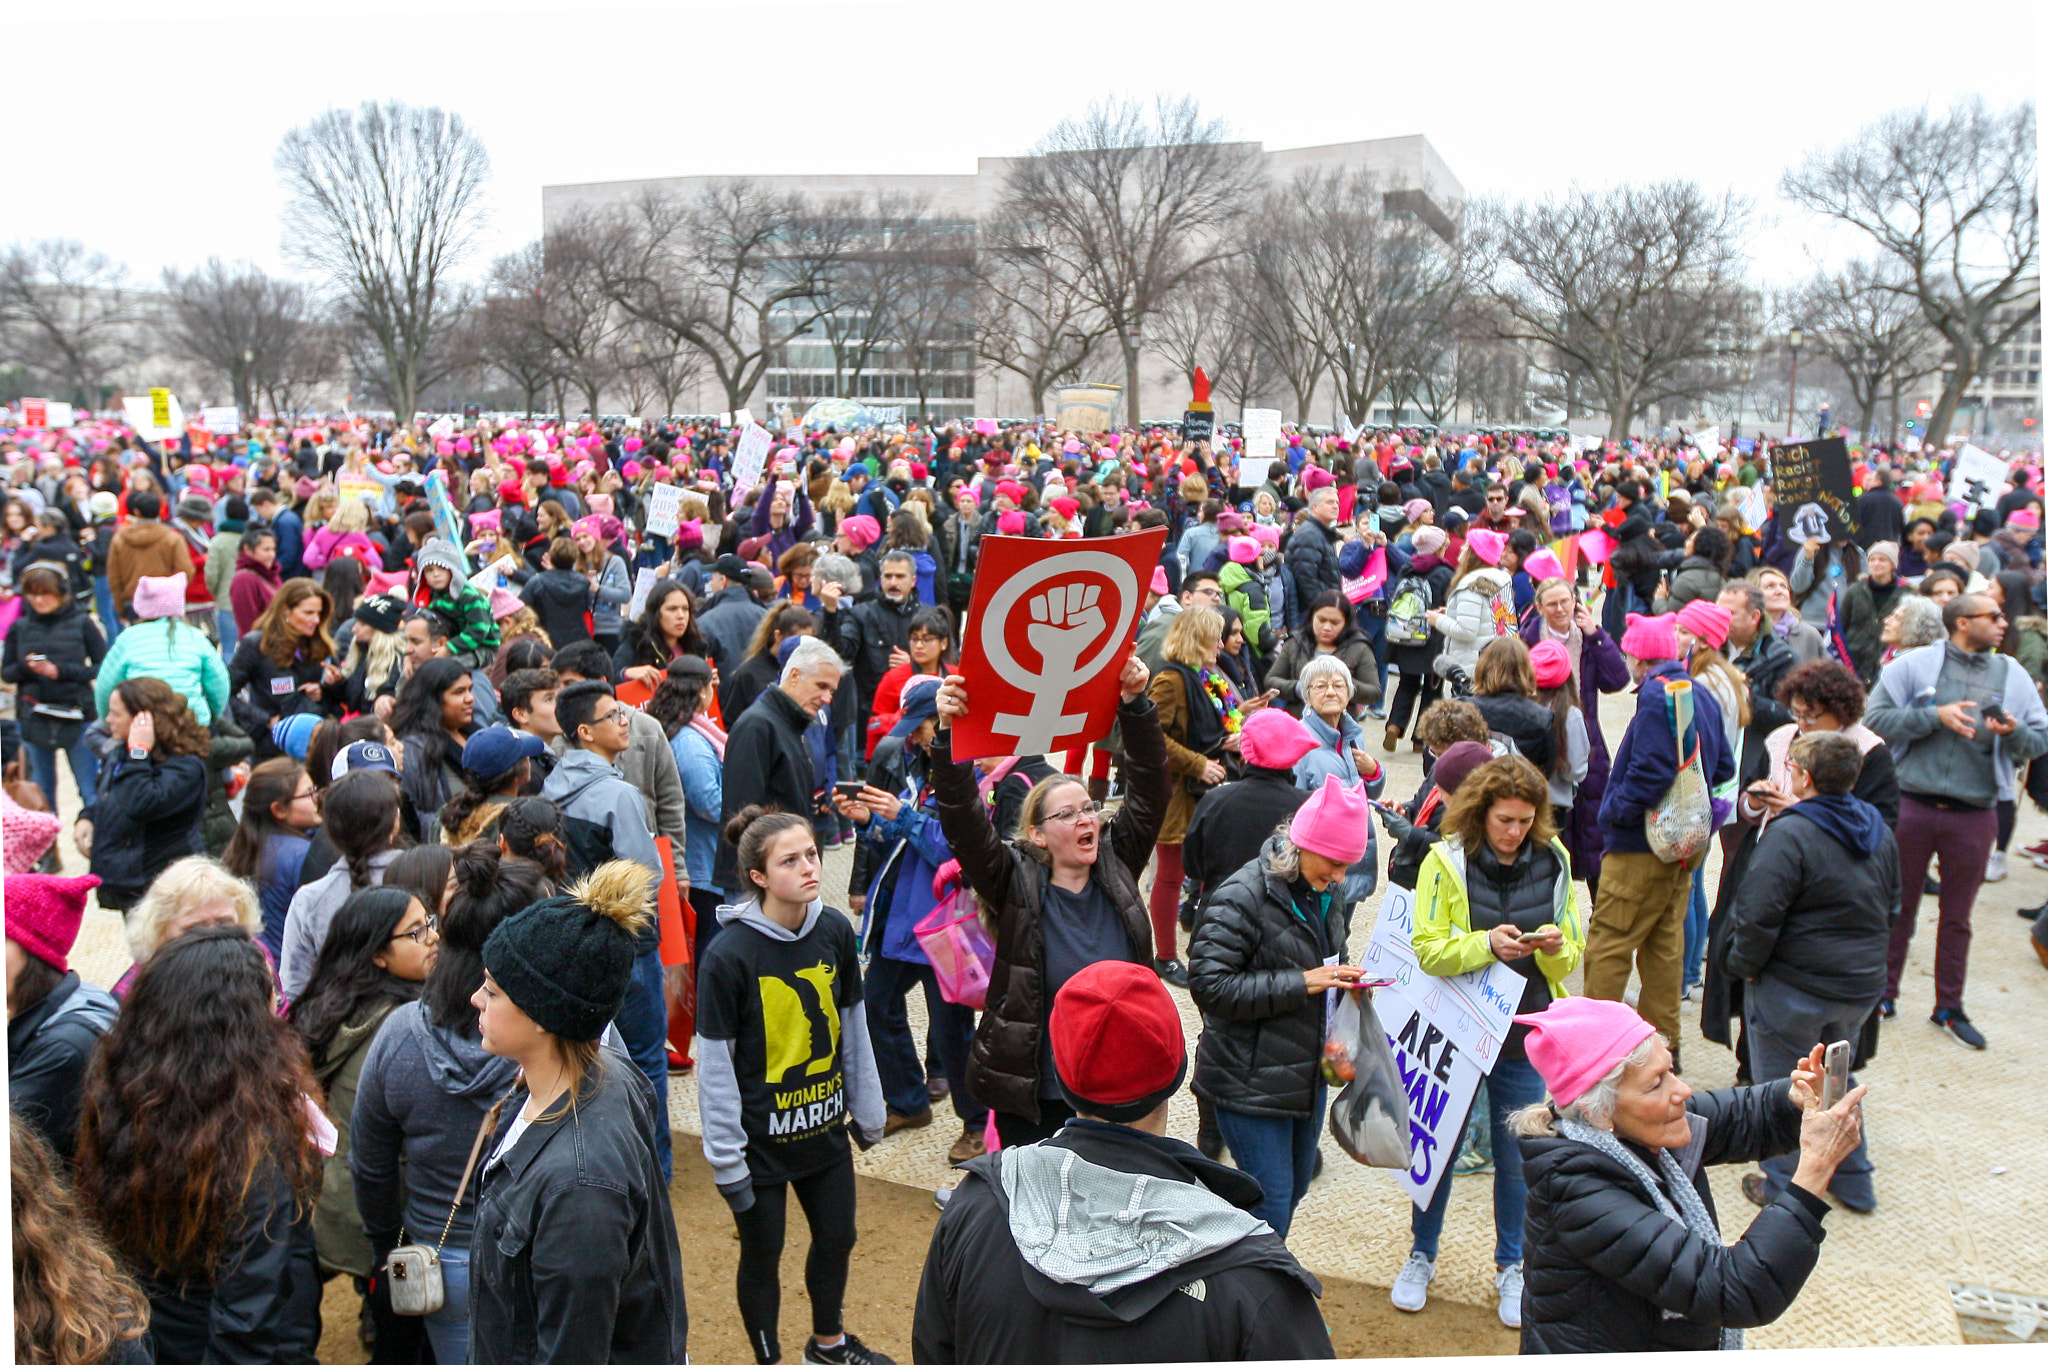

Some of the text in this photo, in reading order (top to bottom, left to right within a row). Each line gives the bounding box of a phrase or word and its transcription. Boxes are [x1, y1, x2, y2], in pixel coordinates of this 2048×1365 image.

[1398, 1009, 1459, 1085] ARE
[769, 1089, 844, 1136] MARCH
[775, 1072, 843, 1110] WOMEN'S
[1385, 1032, 1450, 1134] MAN
[1409, 1119, 1437, 1186] TS
